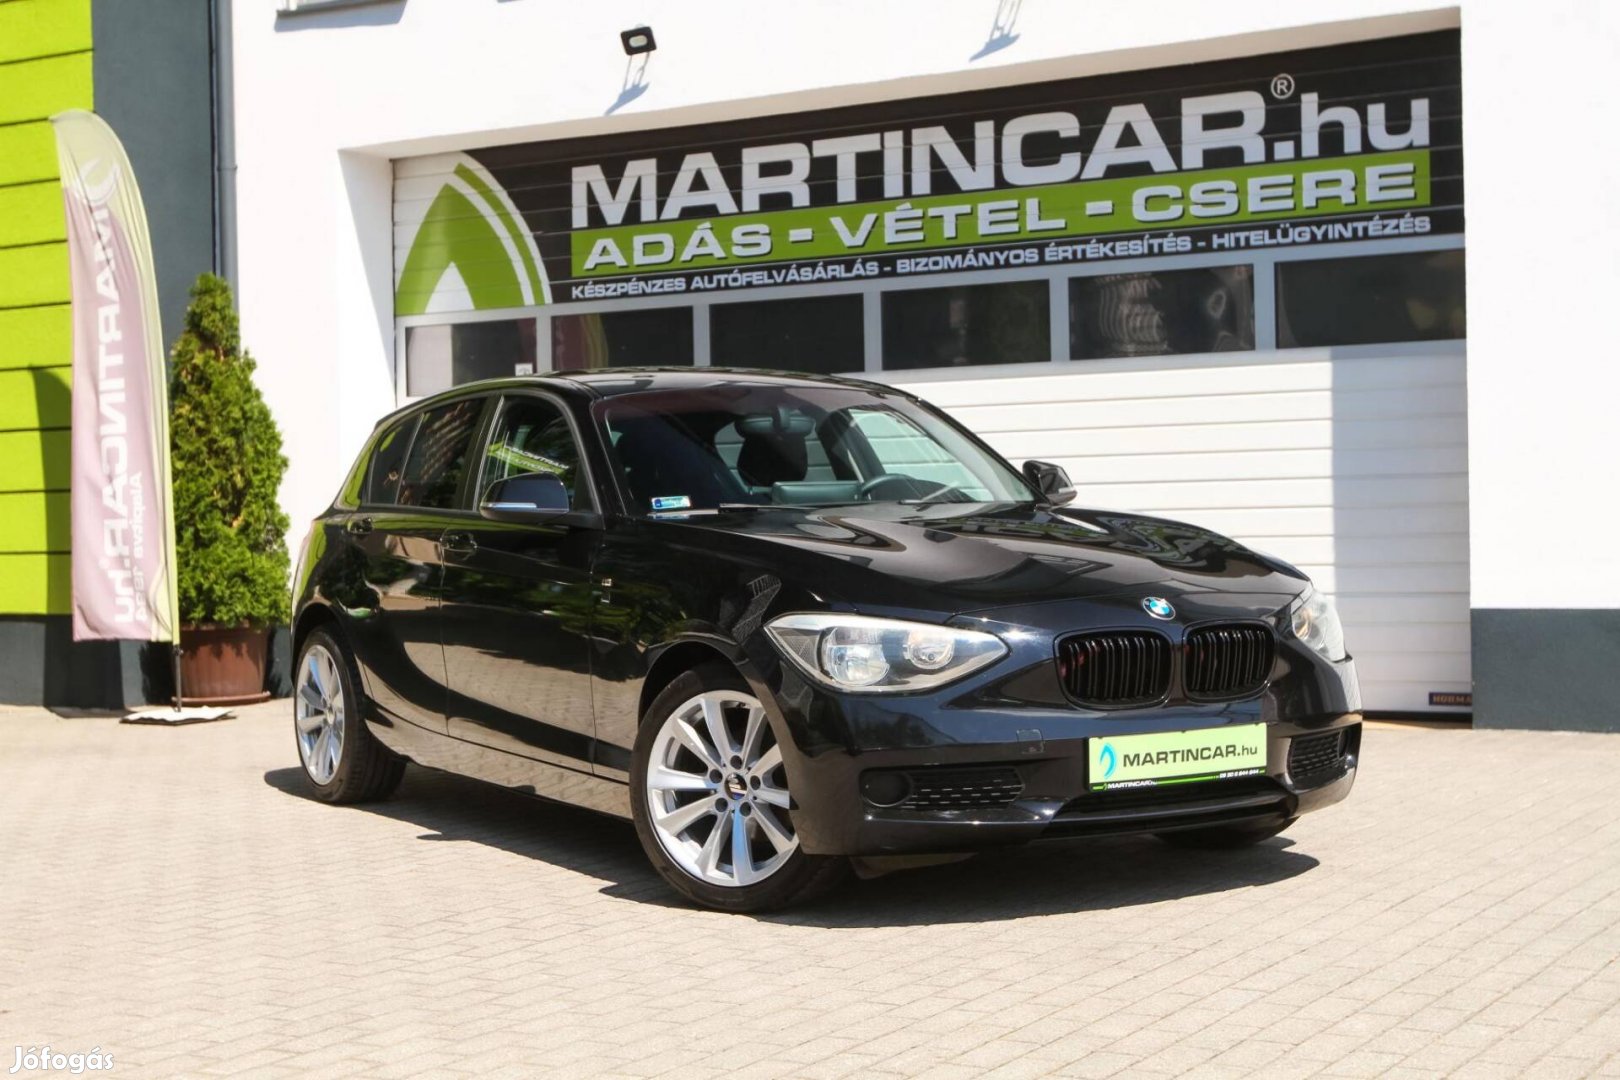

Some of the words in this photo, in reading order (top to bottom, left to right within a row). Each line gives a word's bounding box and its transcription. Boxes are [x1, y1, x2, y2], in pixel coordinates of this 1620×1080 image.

[572, 91, 1430, 228] MARTINCAR.hu
[572, 277, 686, 299] KÉSZPÉNZES
[690, 258, 879, 290] AUTÓFELVÁSÁRLÁS
[896, 247, 1039, 273] BIZOMÁNYOS
[1044, 233, 1192, 262] ÉRTÉKESÍTÉS
[1212, 213, 1431, 248] HITELÜGYINTÉZÉS
[583, 221, 772, 270] ADÁS
[829, 198, 1066, 247] VÉTEL
[1132, 162, 1416, 222] CSERE
[1123, 744, 1258, 767] MARTINCAR.hu
